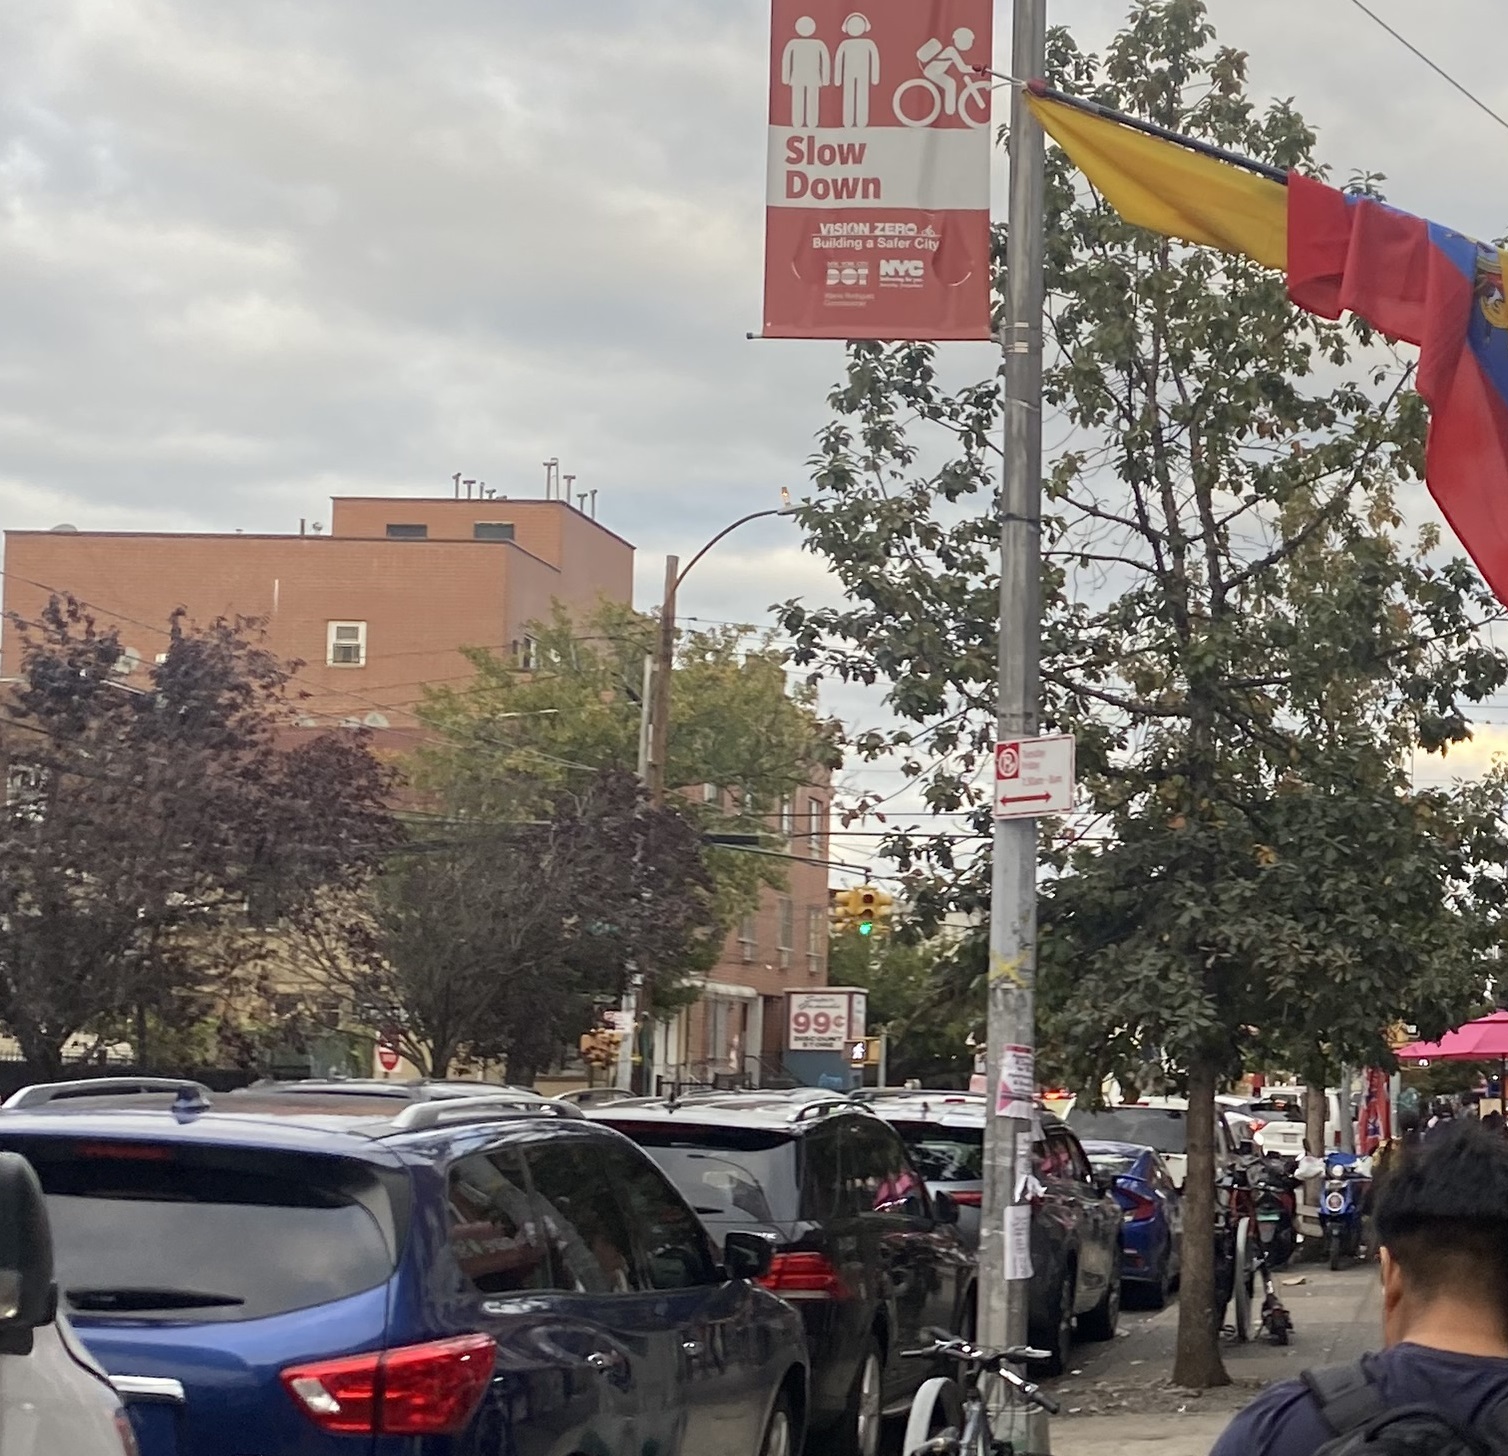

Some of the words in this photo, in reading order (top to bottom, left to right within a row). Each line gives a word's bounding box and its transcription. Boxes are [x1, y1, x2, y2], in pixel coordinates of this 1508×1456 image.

[785, 135, 867, 166] Slow
[786, 170, 881, 200] Down
[820, 223, 869, 236] VISION
[874, 223, 918, 236] ZERO
[812, 238, 863, 251] Building
[866, 239, 874, 249] a
[878, 238, 910, 249] Safer
[914, 238, 940, 252] City
[826, 268, 869, 286] DOT
[880, 259, 924, 277] NYC
